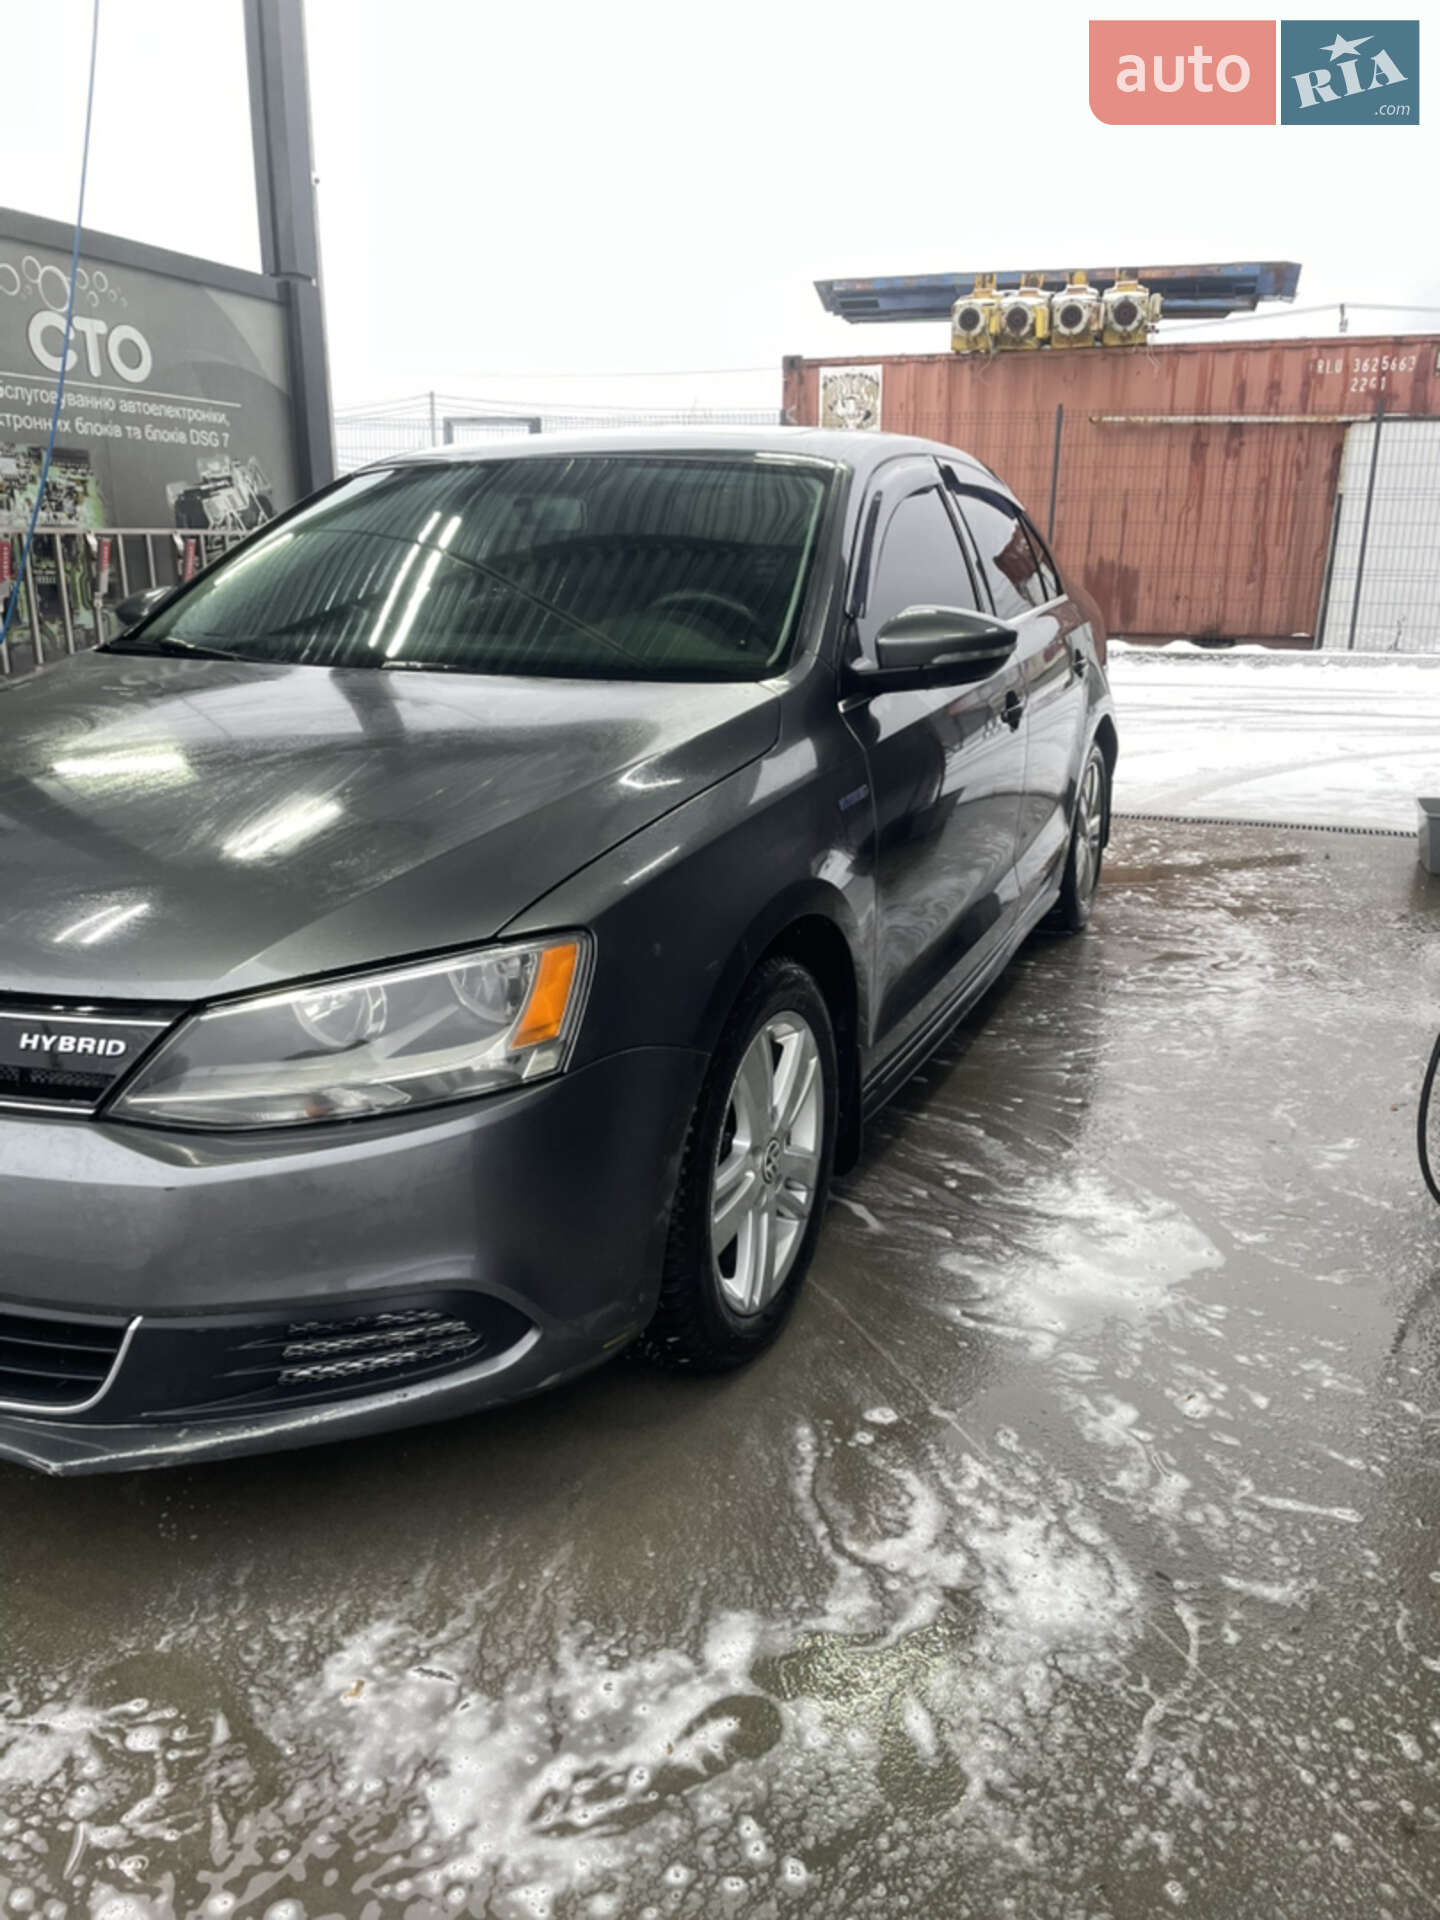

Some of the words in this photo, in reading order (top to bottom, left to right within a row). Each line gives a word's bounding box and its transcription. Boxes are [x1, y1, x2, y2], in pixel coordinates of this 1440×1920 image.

[28, 310, 152, 383] СТО
[1309, 358, 1343, 374] RLU
[1353, 355, 1417, 373] 3625663
[189, 428, 220, 447] DSG
[221, 432, 231, 448] 7
[19, 1032, 127, 1057] HYBRID
